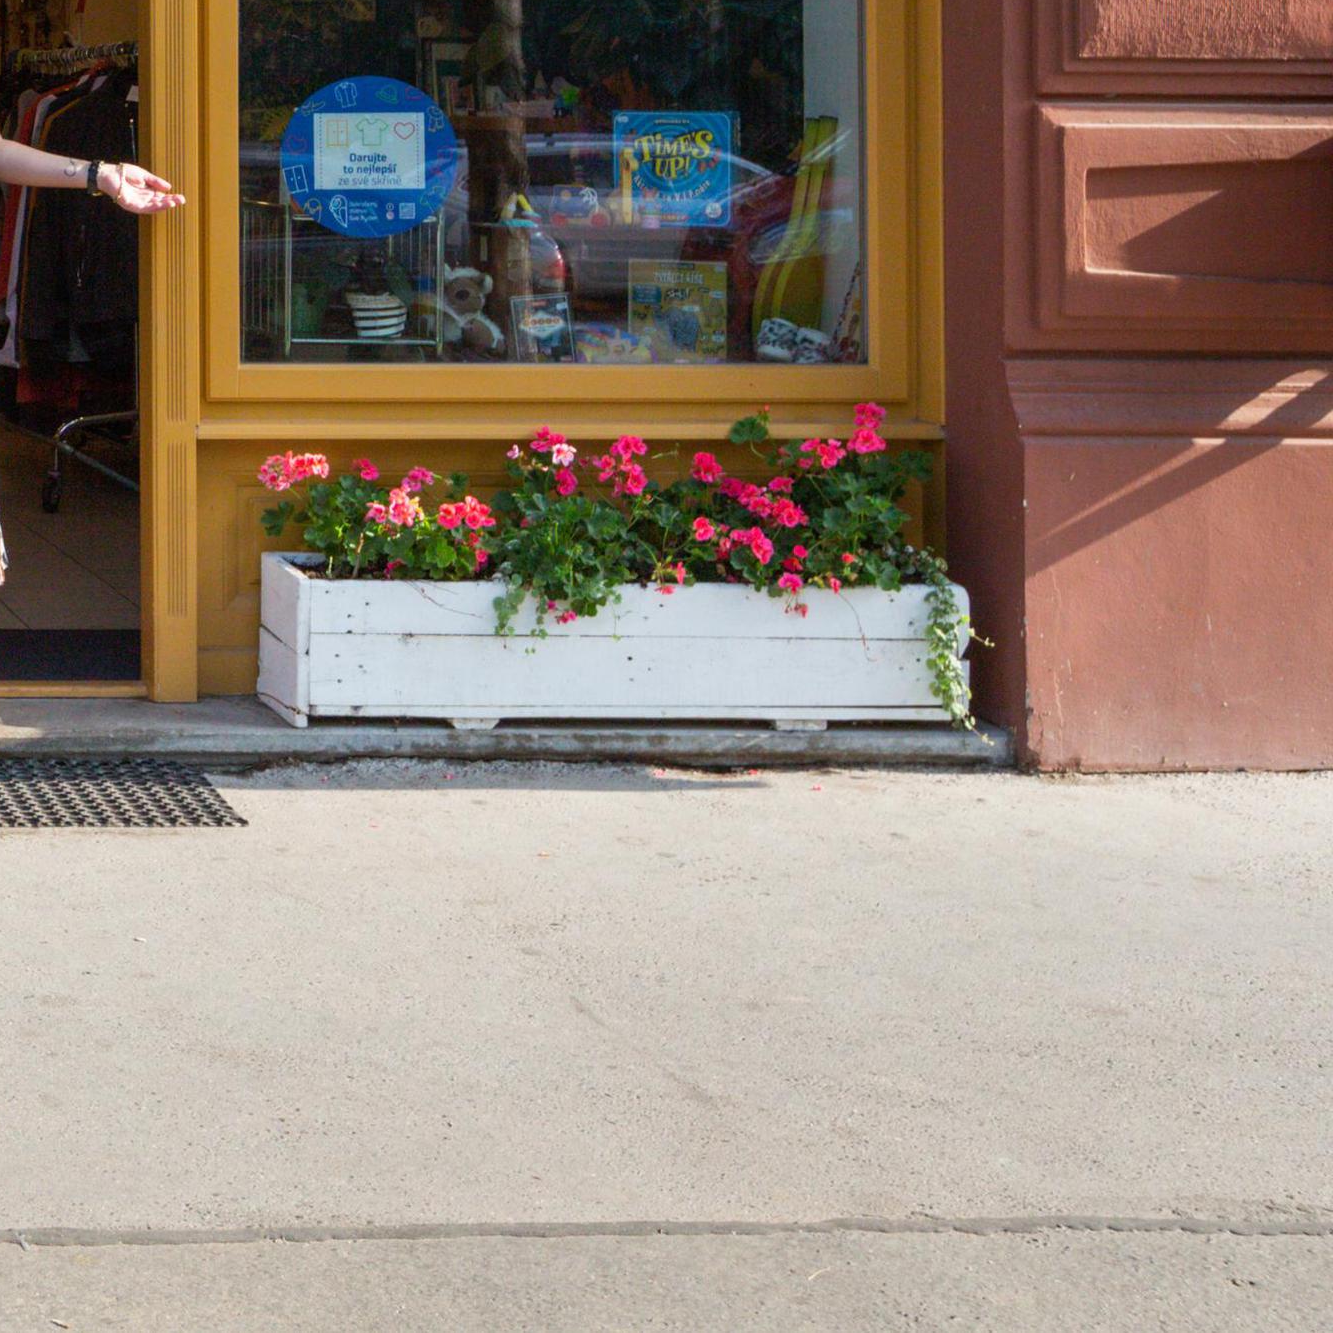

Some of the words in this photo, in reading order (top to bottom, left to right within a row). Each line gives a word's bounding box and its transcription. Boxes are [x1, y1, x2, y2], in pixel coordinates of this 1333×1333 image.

[349, 152, 388, 165] Darujte
[343, 165, 354, 174] to
[356, 163, 398, 175] nejlepší
[654, 156, 691, 180] UP!
[338, 177, 350, 186] ze
[352, 176, 370, 186] své
